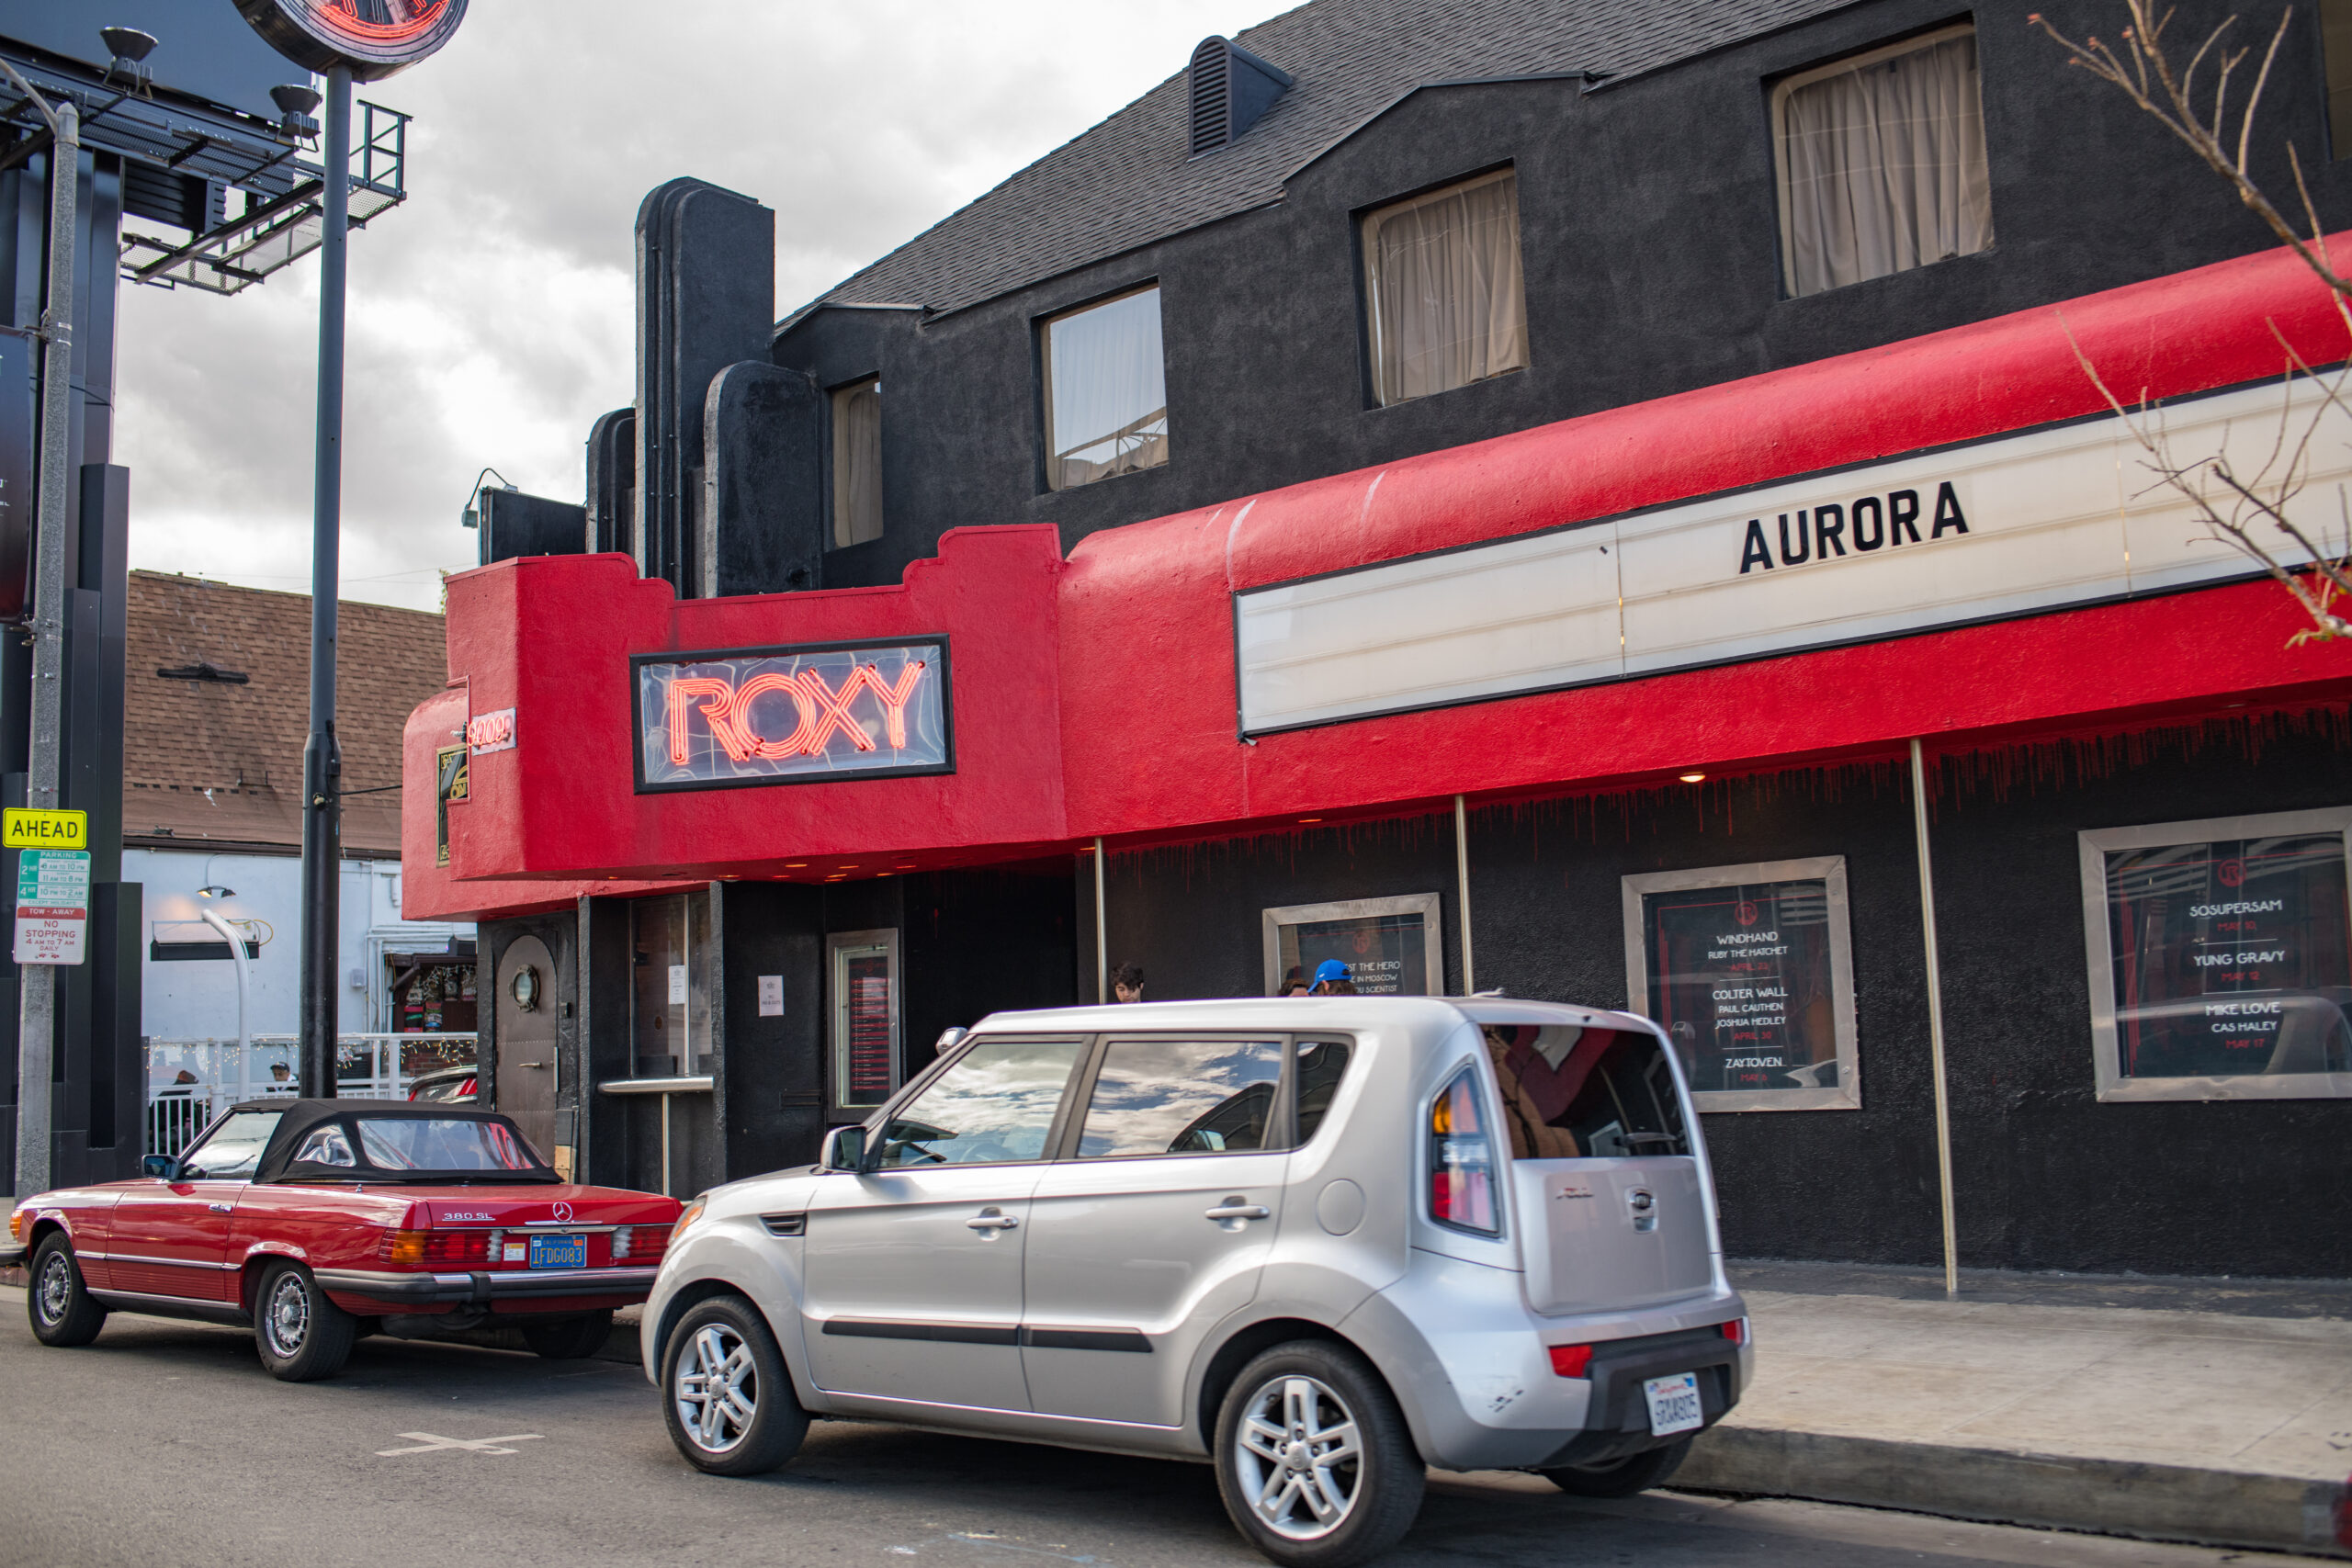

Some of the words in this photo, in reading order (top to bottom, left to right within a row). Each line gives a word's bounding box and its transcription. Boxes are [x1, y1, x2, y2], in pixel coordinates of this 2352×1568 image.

[1739, 481, 1969, 574] AURORA
[669, 661, 924, 765] ROXY
[467, 716, 507, 746] 9009
[12, 819, 78, 839] AHEAD
[21, 865, 28, 874] 2
[20, 887, 27, 897] 4
[2189, 899, 2283, 917] SOSUPERSAM
[2217, 921, 2242, 931] MAY
[26, 930, 75, 938] STOPPING
[1716, 931, 1779, 945] WINDHAND
[1708, 950, 1728, 959] RUBY
[1730, 949, 1747, 957] THE
[1748, 945, 1789, 956] HATCHET
[2194, 953, 2233, 966] YUNG
[2236, 950, 2285, 964] GRAVY
[1359, 963, 1375, 972] THE
[1377, 961, 1401, 971] HERO
[1730, 963, 1756, 971] APRIL
[1365, 974, 1398, 983] MOSCOW
[2221, 972, 2245, 981] MAY
[1366, 985, 1397, 994] SCIENTIST
[1712, 988, 1754, 999] COLTER
[1756, 987, 1789, 998] WALL
[1718, 1005, 1740, 1013] PAUL
[1741, 1002, 1784, 1012] CAUTHEN
[2205, 1003, 2239, 1016] MIKE
[2242, 1001, 2281, 1015] LOVE
[1714, 1018, 1750, 1029] JOSHUA
[1751, 1016, 1787, 1026] HEDLEY
[2211, 1022, 2235, 1032] CAS
[2237, 1021, 2278, 1032] HALEY
[1734, 1032, 1758, 1040] APRIL
[2226, 1040, 2250, 1049] MAY
[2254, 1038, 2265, 1048] 17
[1725, 1056, 1783, 1068] ZAYTOVEN
[1740, 1073, 1758, 1082] MAY
[533, 1247, 582, 1264] 1FDG083
